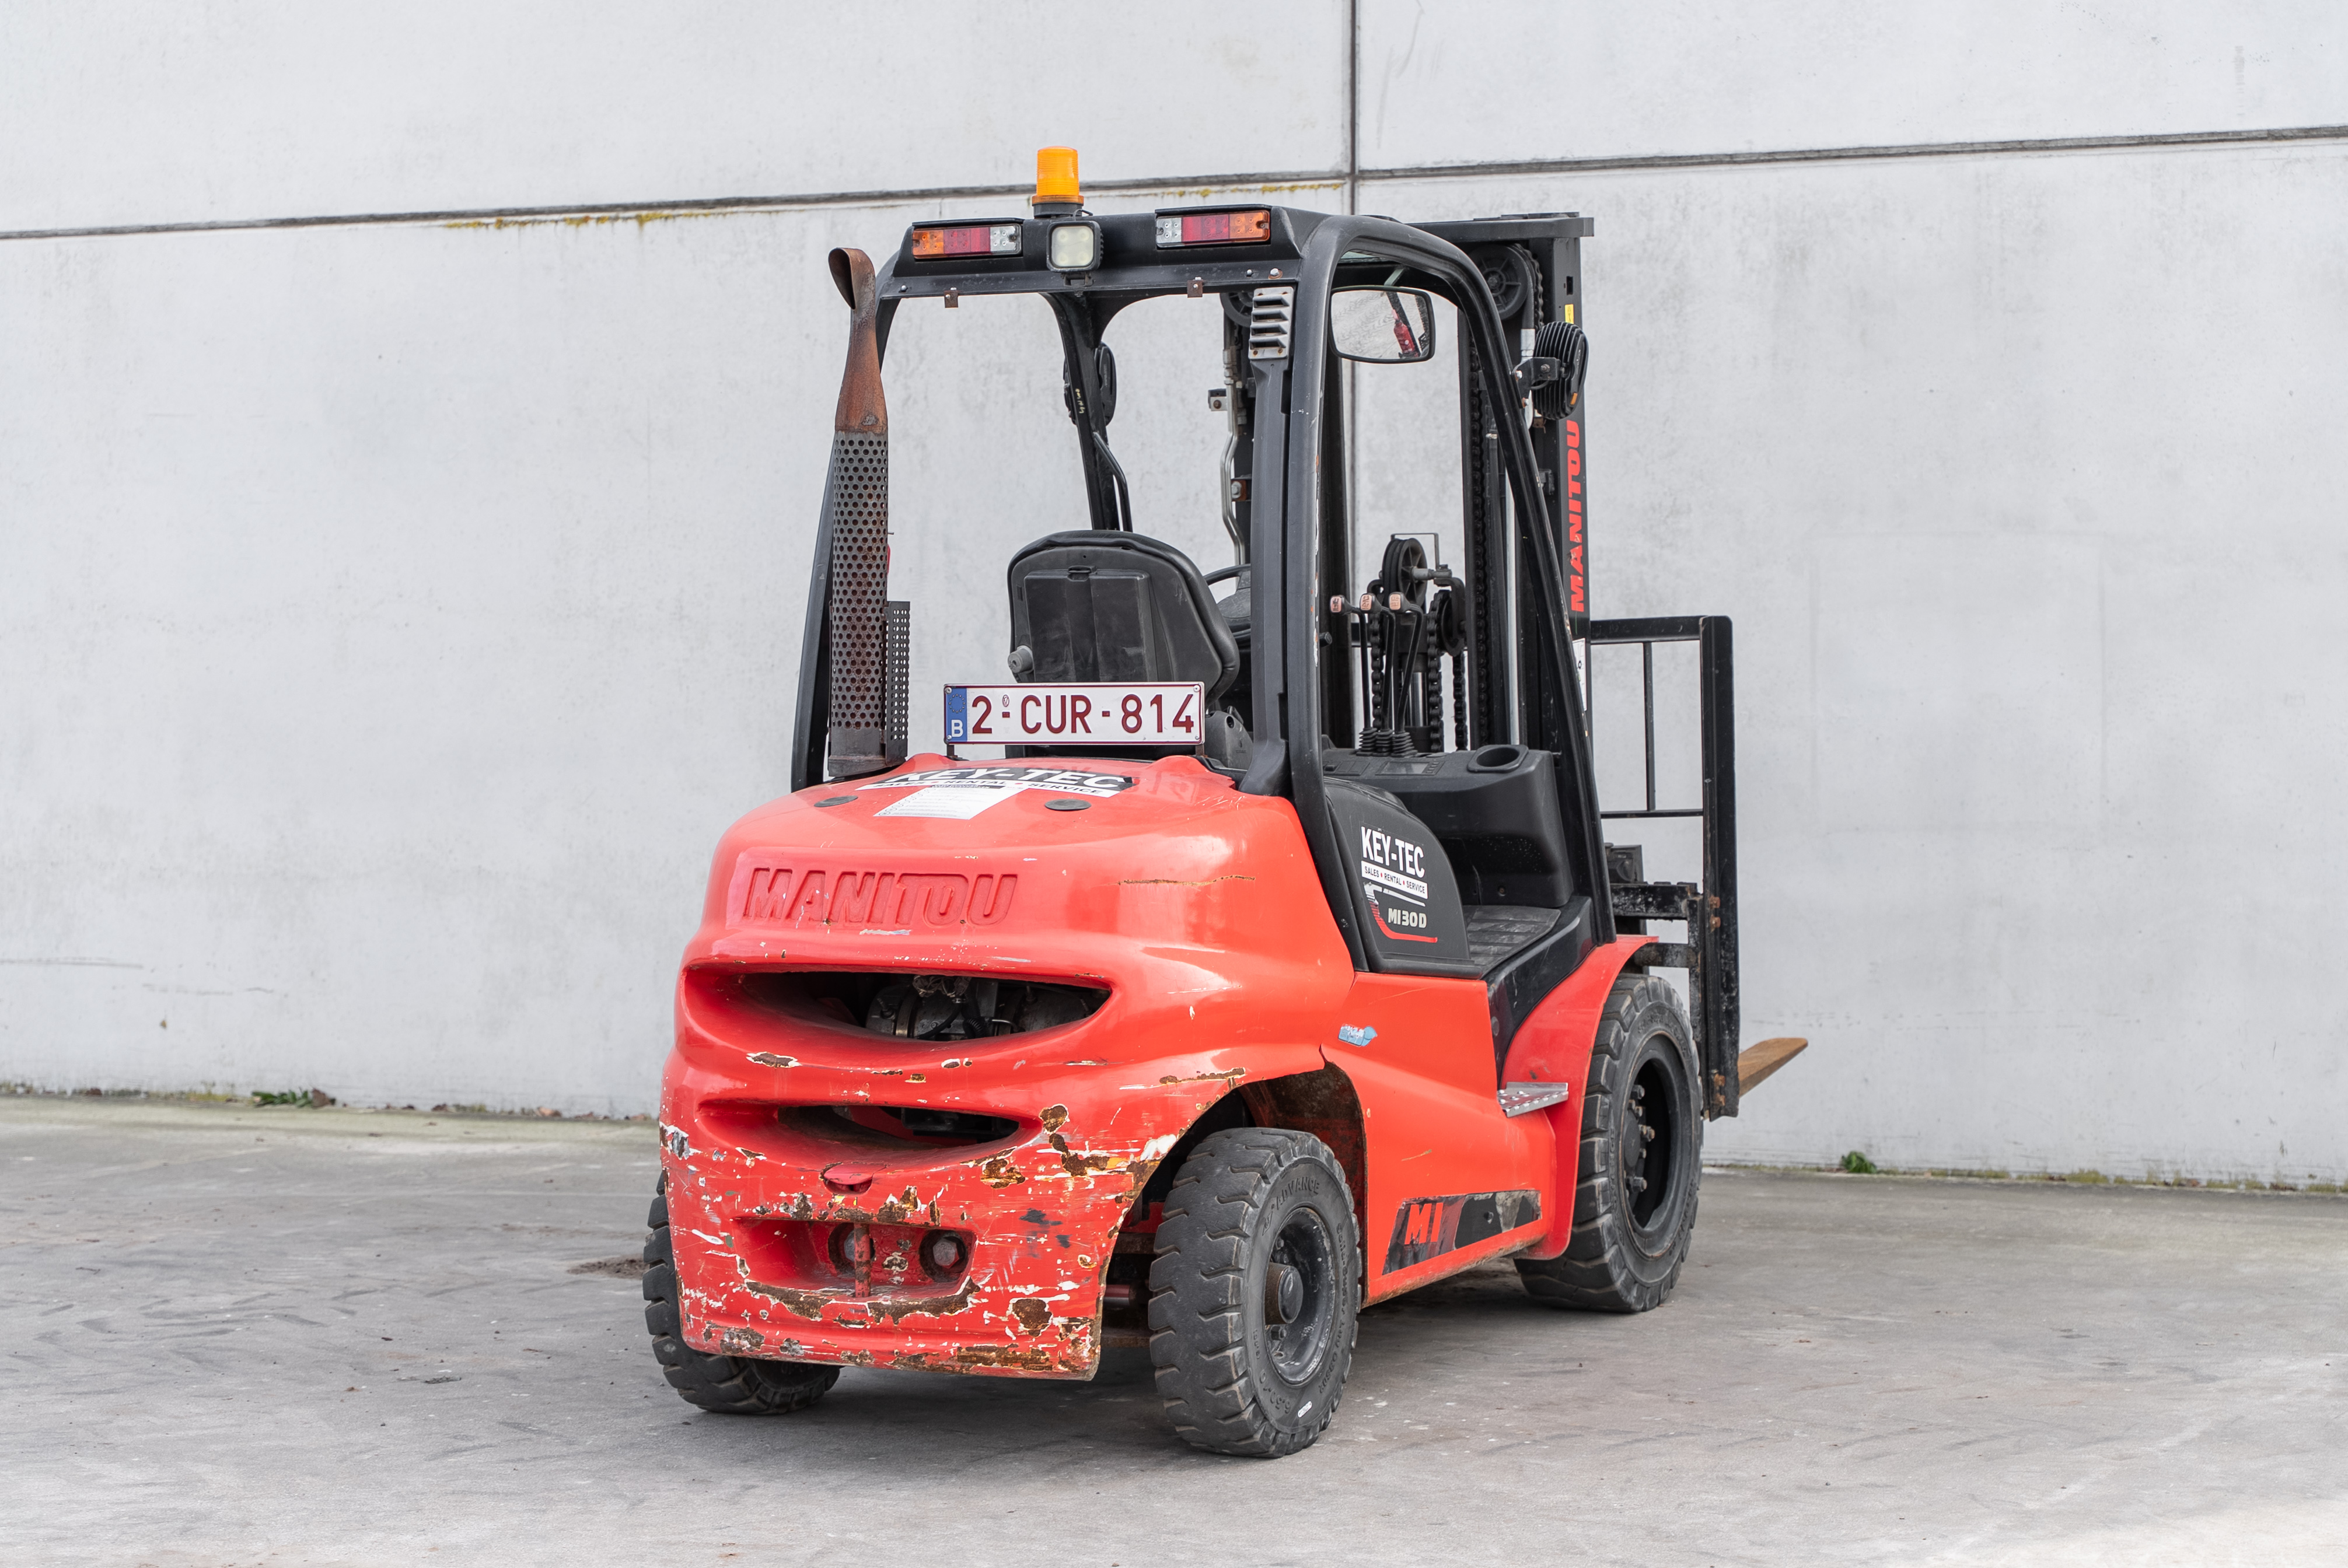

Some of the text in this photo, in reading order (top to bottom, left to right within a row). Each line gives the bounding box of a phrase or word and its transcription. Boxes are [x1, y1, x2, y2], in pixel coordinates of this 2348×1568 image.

[1566, 420, 1585, 612] MANITOU
[951, 719, 963, 737] B
[972, 694, 1194, 734] 2-CUR-814
[885, 768, 1126, 788] KEY-TEC
[1028, 783, 1104, 794] SERVICE
[1361, 826, 1425, 878] KEY-TEC
[742, 867, 1018, 927] MANITOU
[1364, 866, 1425, 894] SALES RENTAL SERVICE
[1276, 1176, 1320, 1211] ADVANCE
[1404, 1202, 1444, 1245] MI
